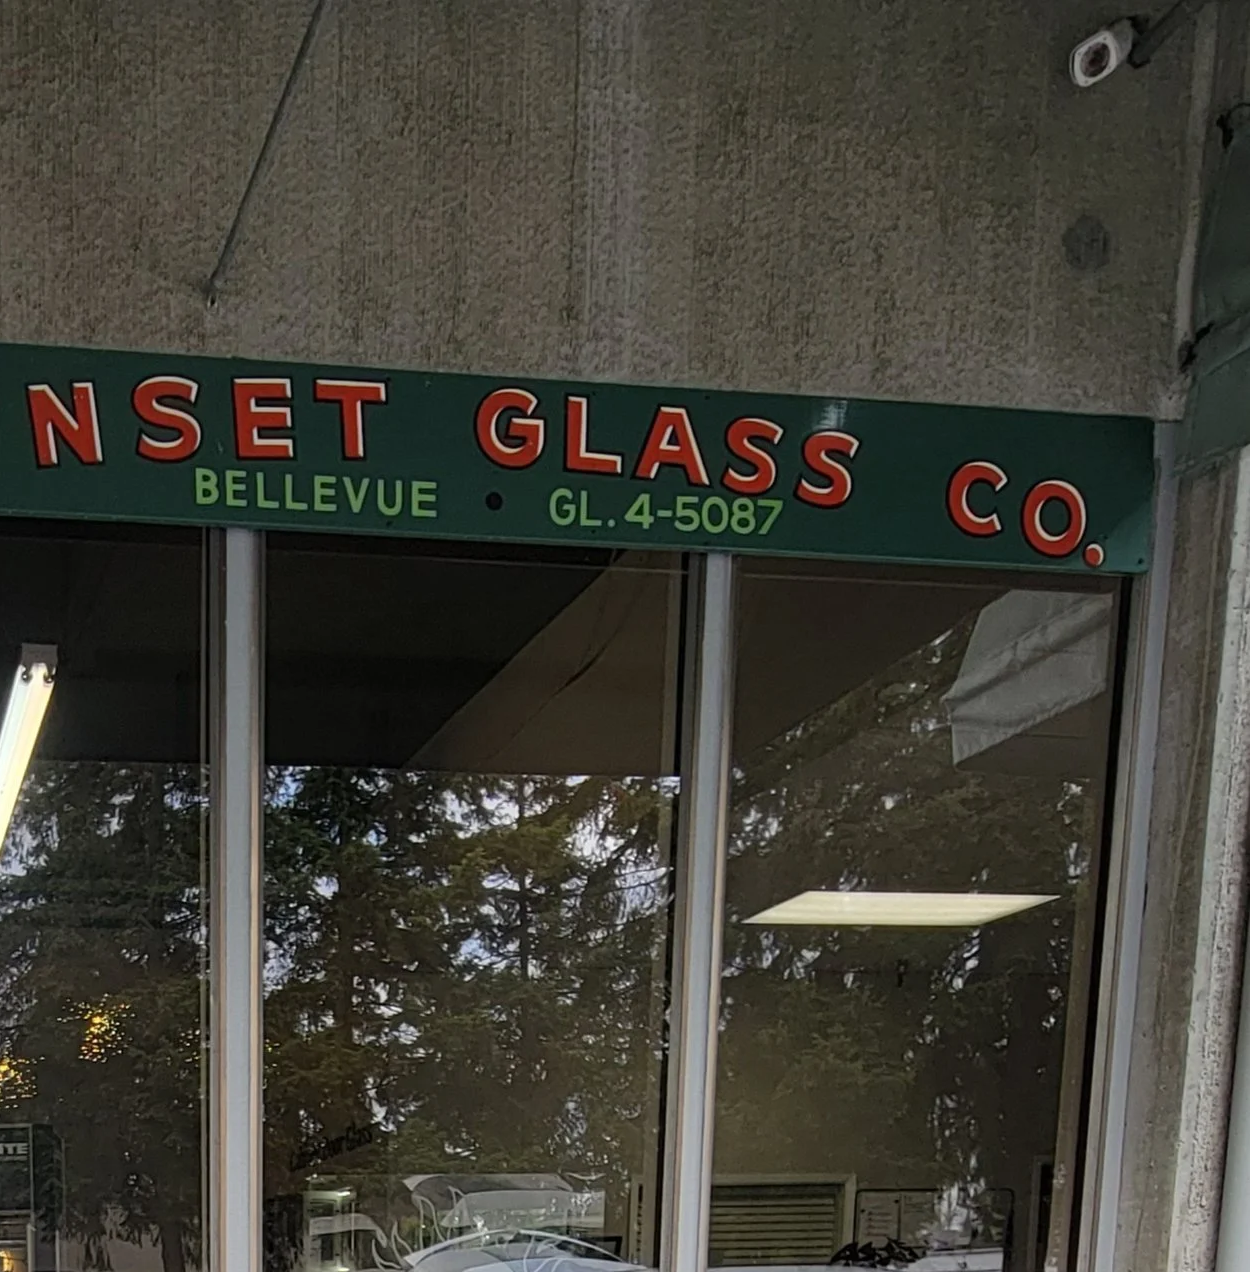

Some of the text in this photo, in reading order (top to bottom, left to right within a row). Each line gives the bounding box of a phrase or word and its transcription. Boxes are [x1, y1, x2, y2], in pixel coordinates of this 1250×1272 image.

[194, 466, 438, 518] BELLEVUE
[473, 388, 861, 509] GLASS
[945, 460, 1106, 569] CO.
